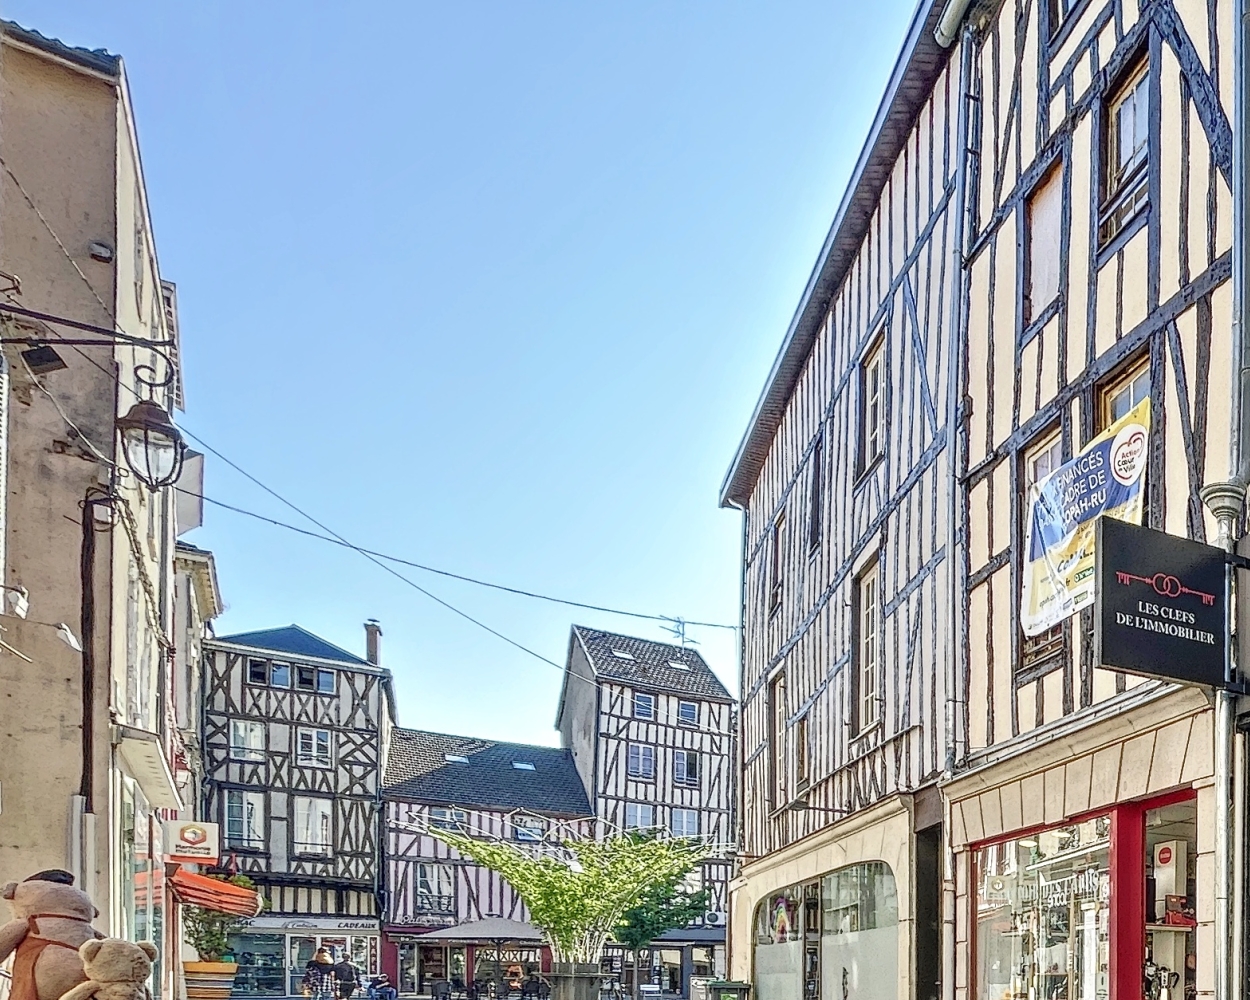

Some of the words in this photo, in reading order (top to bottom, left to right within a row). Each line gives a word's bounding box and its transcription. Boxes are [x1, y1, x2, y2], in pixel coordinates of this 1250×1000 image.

[1088, 470, 1106, 490] DE
[1138, 600, 1160, 617] LES
[1162, 606, 1196, 625] CLEFS
[1115, 611, 1134, 628] DE
[1135, 616, 1216, 646] L'IMMOBILIER
